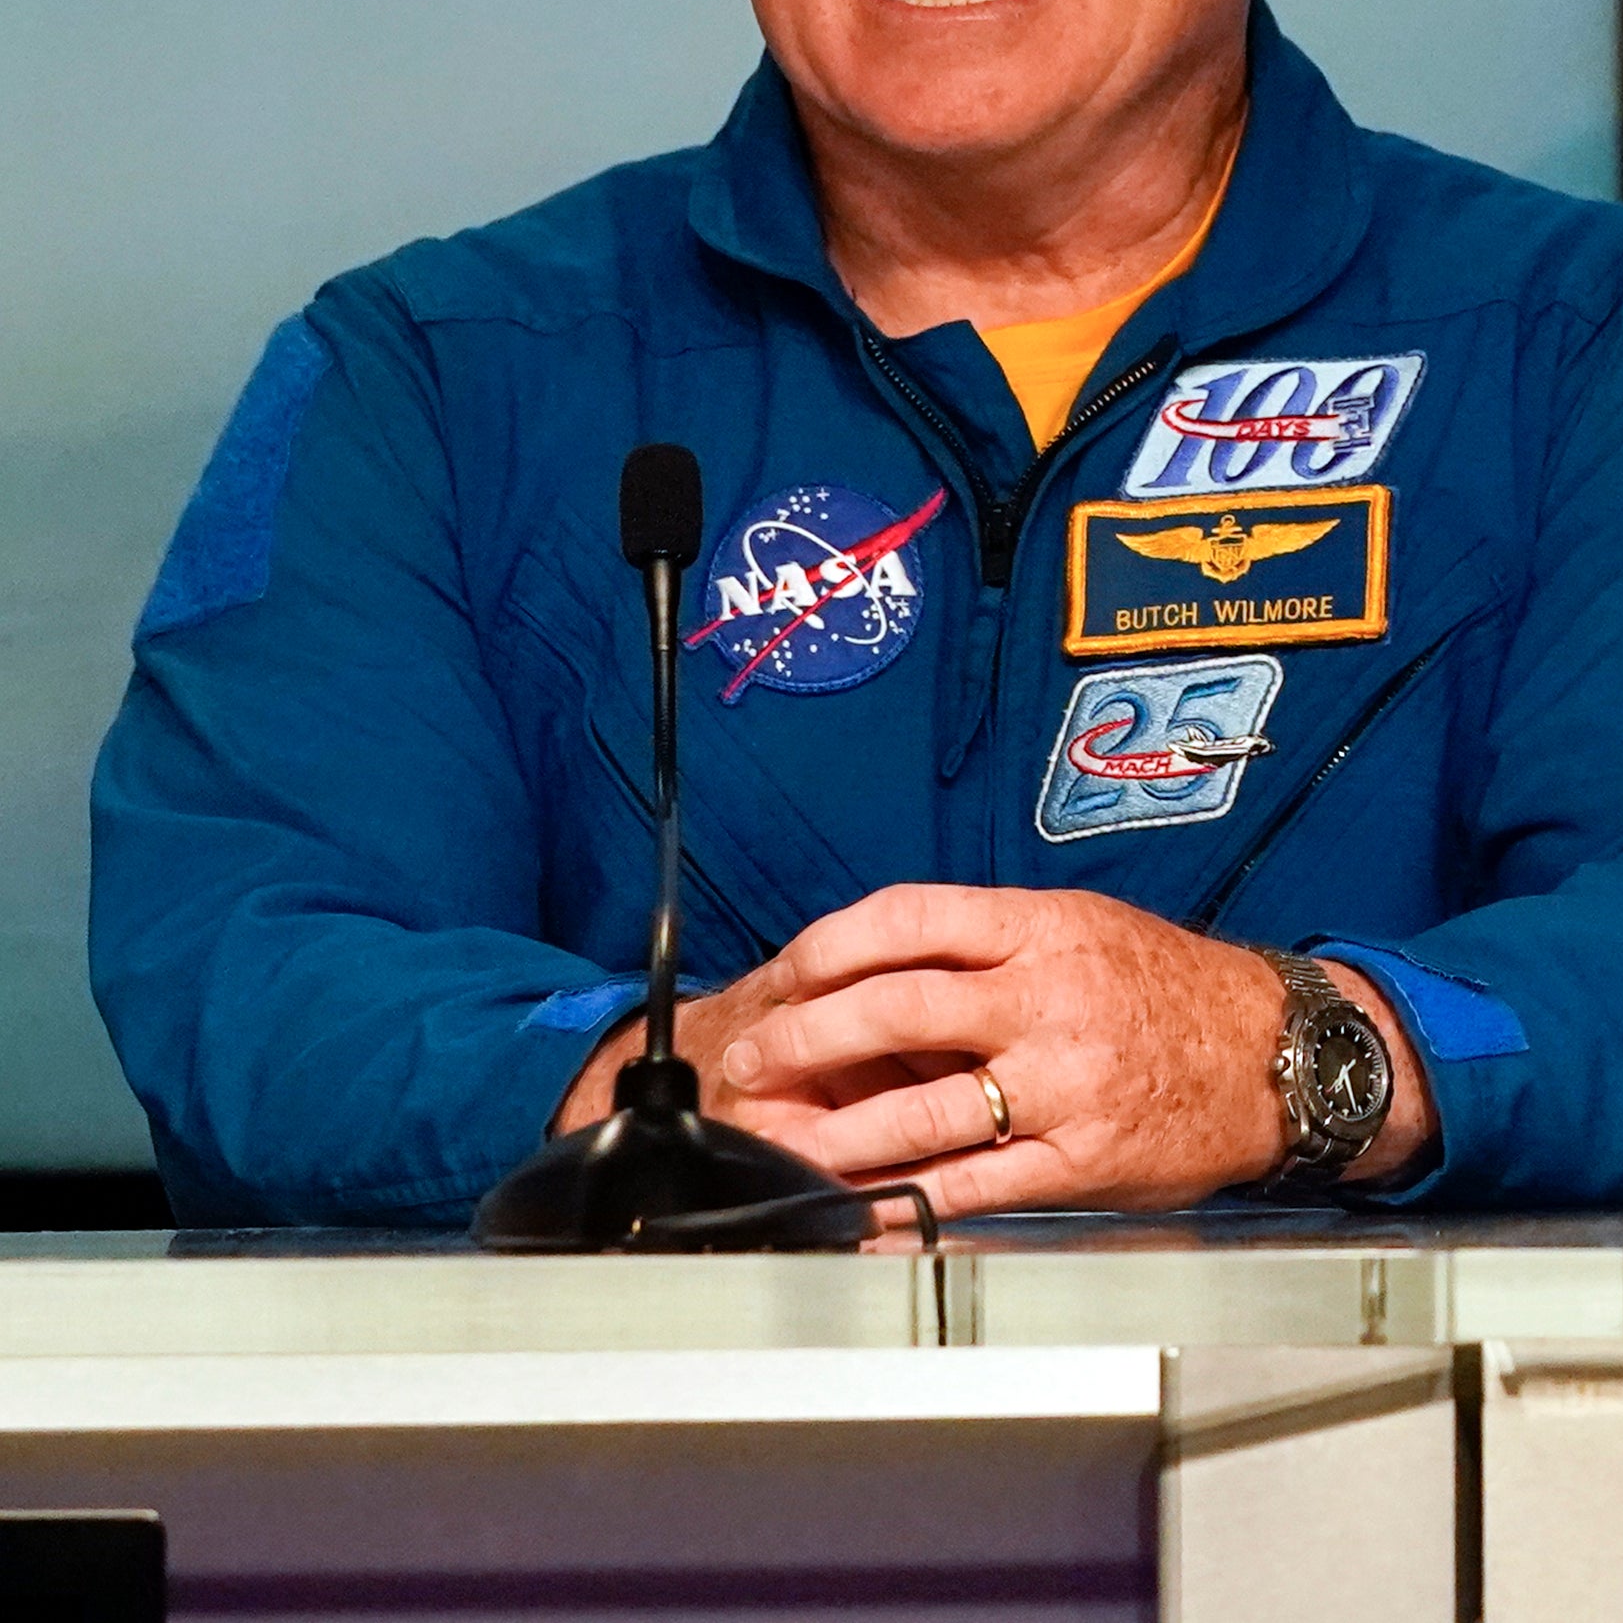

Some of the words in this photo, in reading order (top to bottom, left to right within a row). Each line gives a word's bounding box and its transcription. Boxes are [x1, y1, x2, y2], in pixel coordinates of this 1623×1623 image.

[1139, 363, 1400, 489] 100
[1235, 417, 1313, 442] DAYS
[715, 550, 917, 622] NASA
[1115, 603, 1199, 631] BUTCH
[1213, 595, 1334, 624] WILMORE
[1058, 677, 1243, 820] 25
[1103, 756, 1173, 774] MACH
